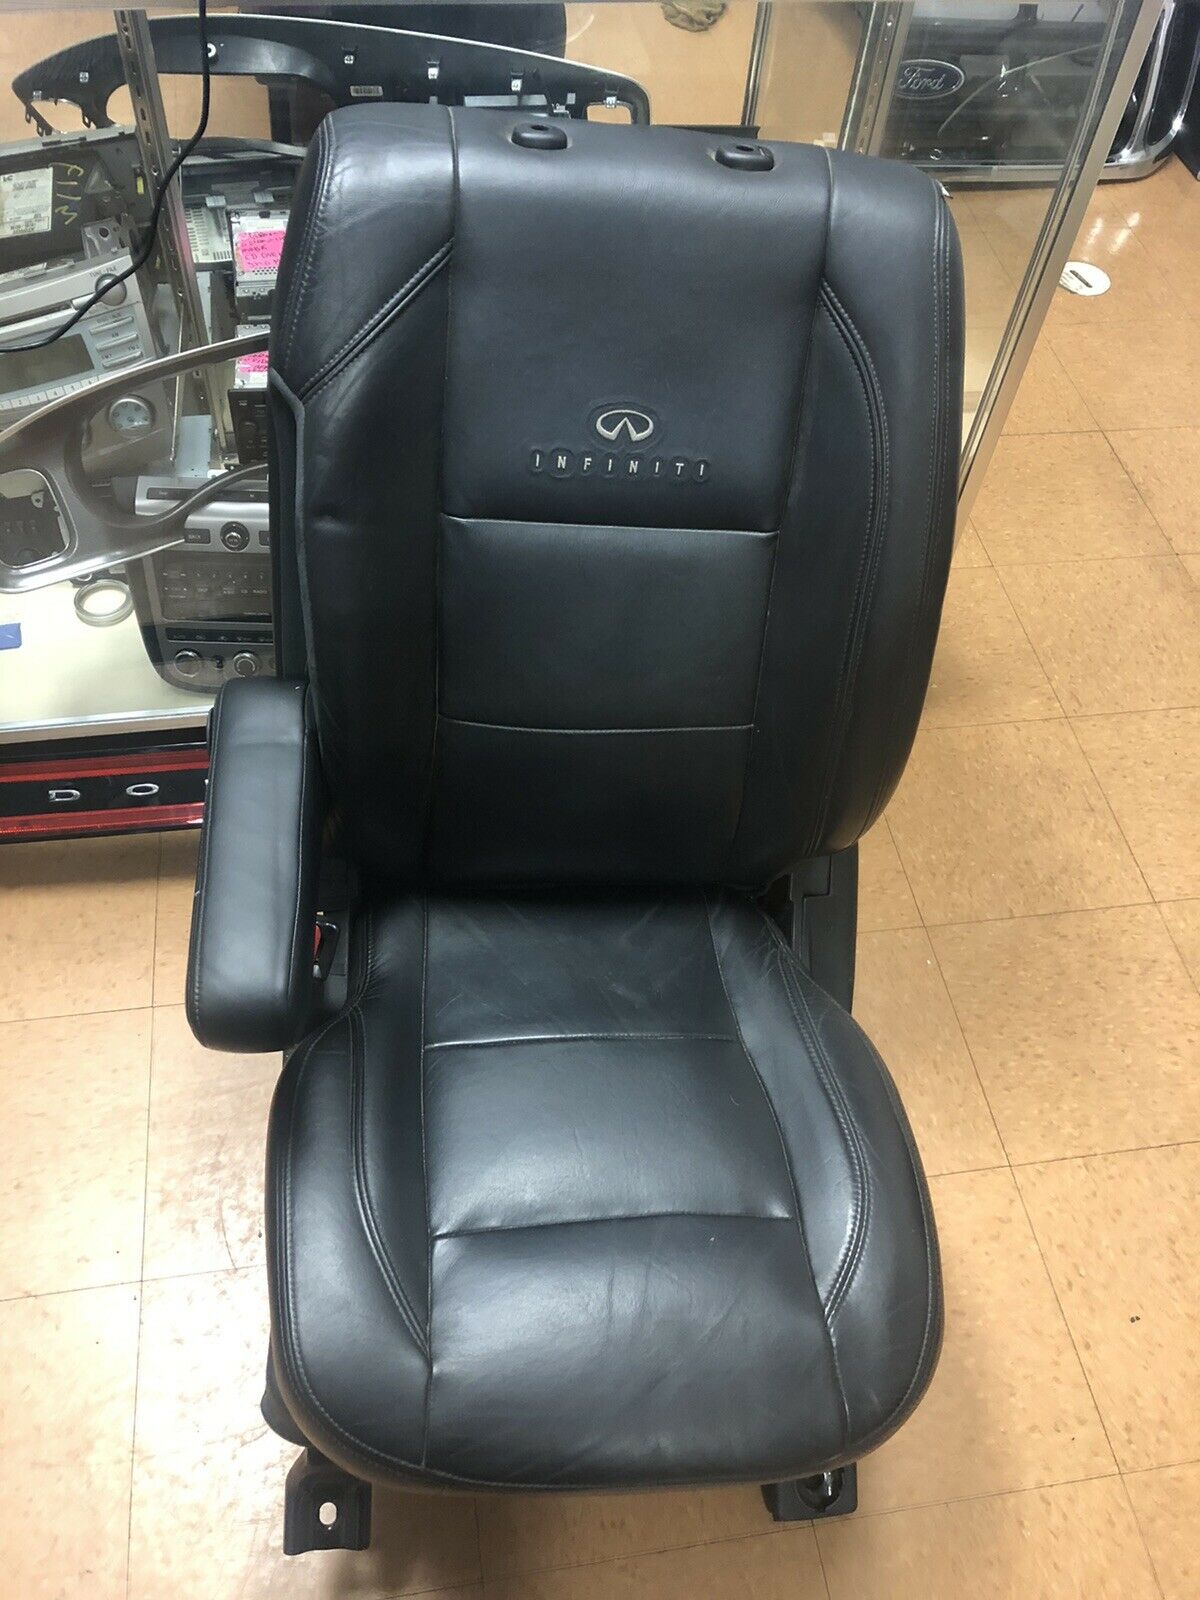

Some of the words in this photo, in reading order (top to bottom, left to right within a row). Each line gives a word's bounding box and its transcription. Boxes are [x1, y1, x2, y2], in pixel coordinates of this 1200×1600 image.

[899, 66, 946, 90] Ford
[534, 453, 705, 477] INFINITI
[48, 781, 209, 802] DO
